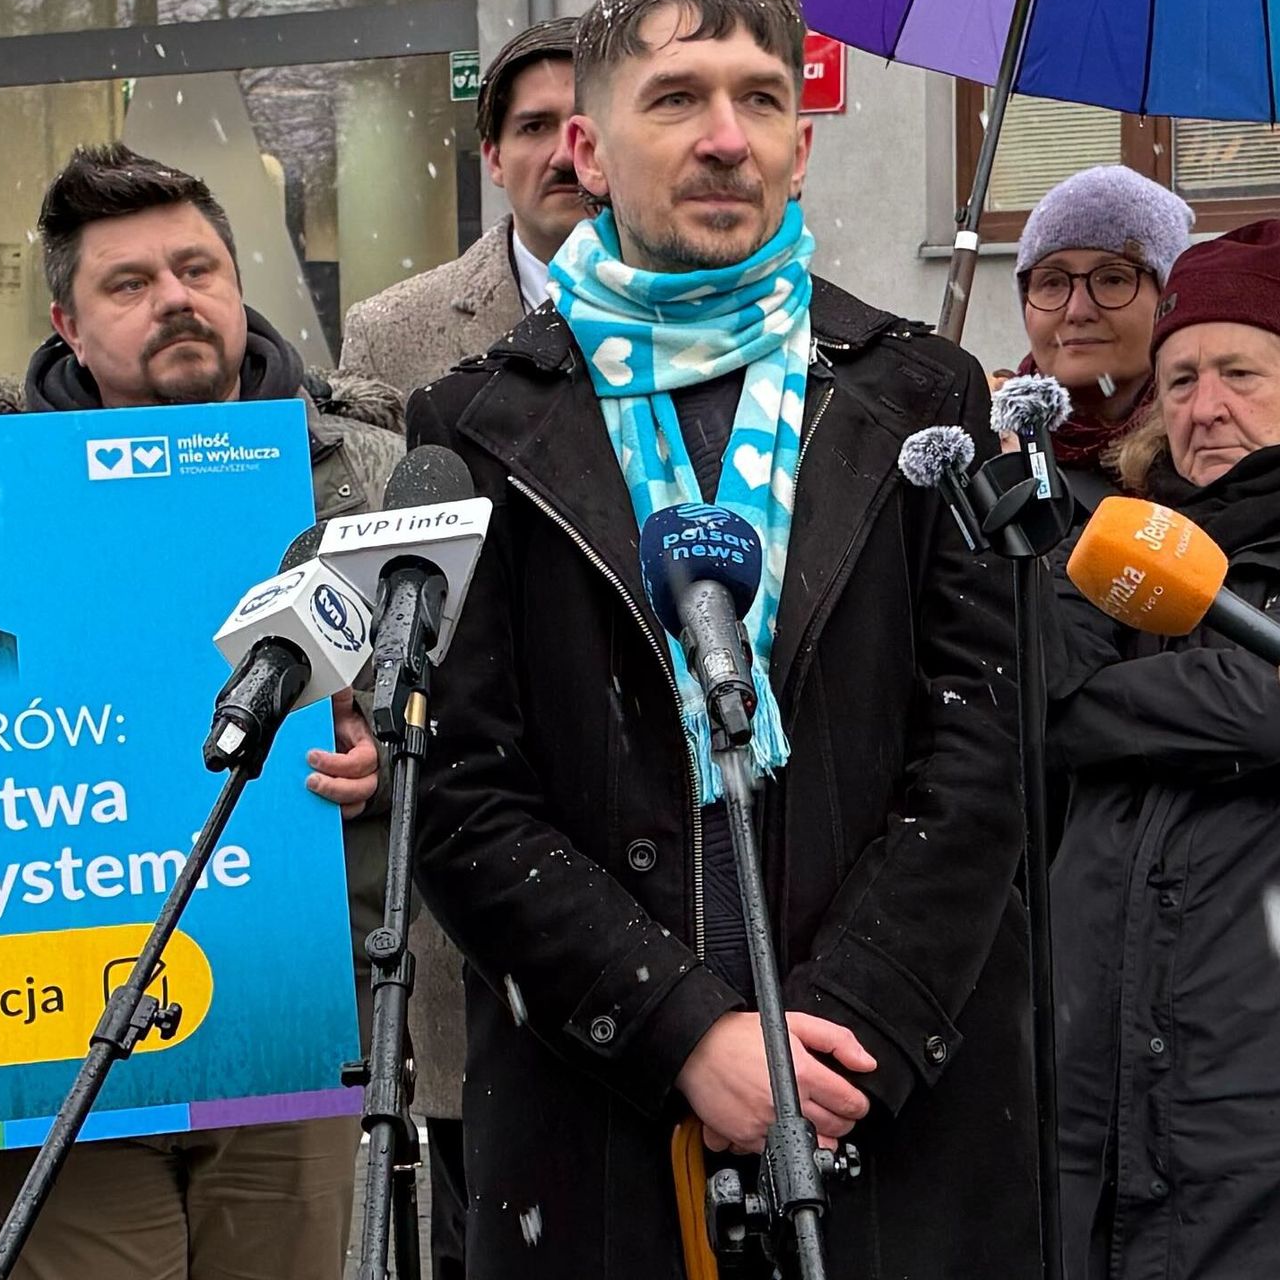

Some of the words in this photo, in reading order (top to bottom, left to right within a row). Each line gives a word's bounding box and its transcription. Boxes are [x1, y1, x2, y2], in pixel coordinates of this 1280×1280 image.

[177, 432, 230, 449] miłość
[179, 449, 204, 463] nie
[207, 446, 280, 464] wyklucza
[338, 520, 389, 540] TVP
[663, 526, 751, 552] polsat
[672, 544, 744, 564] news
